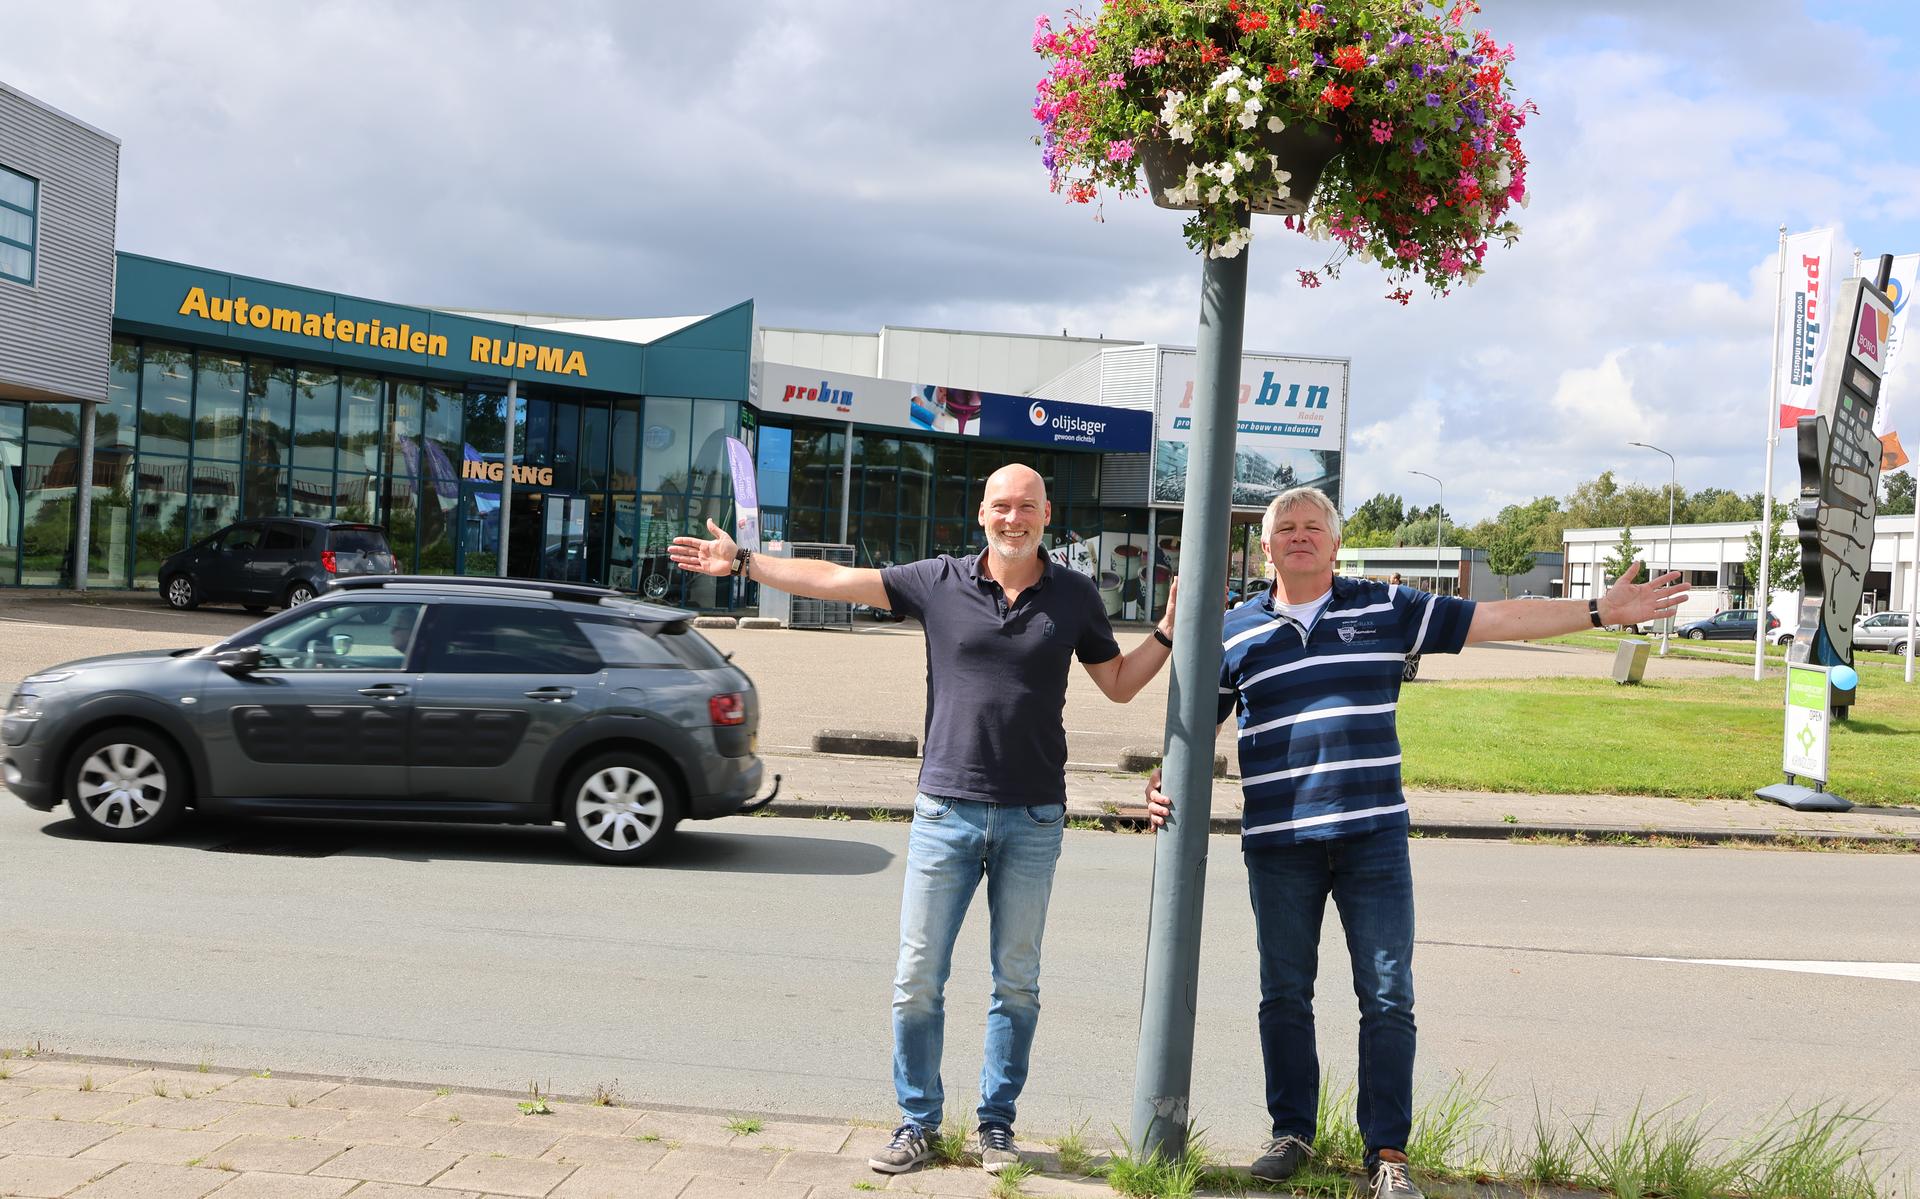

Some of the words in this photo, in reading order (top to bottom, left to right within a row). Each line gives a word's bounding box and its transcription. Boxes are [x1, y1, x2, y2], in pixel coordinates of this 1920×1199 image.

[1795, 314, 1804, 335] bouw
[1802, 254, 1821, 387] probin
[179, 286, 448, 358] Automaterialen
[470, 335, 588, 377] RIJPMA
[1795, 336, 1802, 346] en
[1793, 347, 1802, 382] industrie
[782, 380, 854, 406] probin
[1051, 416, 1107, 434] olijslager
[1250, 422, 1272, 431] bouw
[1284, 424, 1319, 434] industrie
[1054, 433, 1074, 442] gewoon
[1075, 434, 1096, 444] dichtbij
